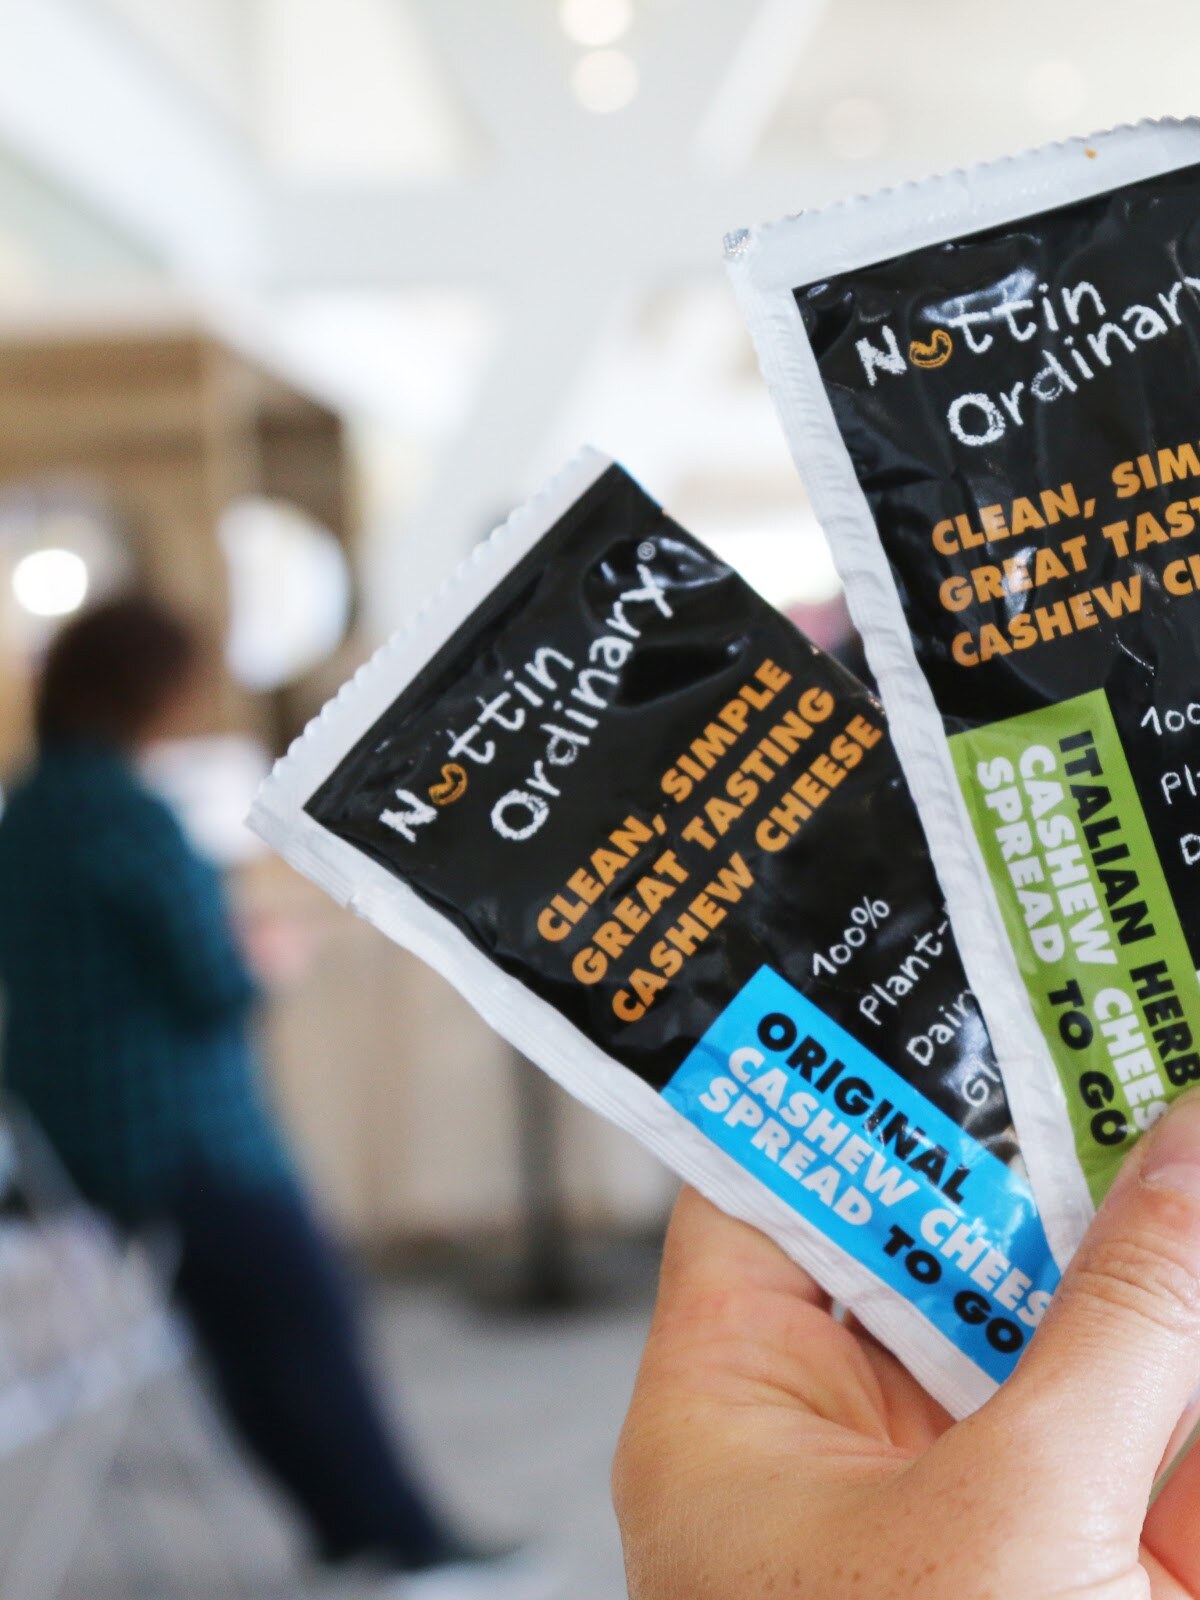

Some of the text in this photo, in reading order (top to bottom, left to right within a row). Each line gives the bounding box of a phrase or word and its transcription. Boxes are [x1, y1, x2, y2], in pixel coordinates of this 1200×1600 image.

[932, 484, 1096, 556] CLEAN,
[939, 537, 1088, 613] GREAT
[951, 577, 1144, 668] CASHEW
[537, 658, 792, 943] CLEAN, SIMPLE
[571, 687, 835, 985] GREAT TASTING
[611, 714, 883, 1023] CASHEW CHEESE
[1057, 730, 1156, 947] ITALIAN
[812, 896, 890, 978] 100%
[859, 903, 949, 1025] Plant-
[906, 989, 973, 1067] Dair
[976, 756, 1128, 1146] SPREAD TO GO
[1019, 744, 1169, 1130] CASHEW CHEES
[698, 1077, 1024, 1354] SPREAD TO GO
[728, 1047, 1054, 1328] CASHEW CHEES
[756, 1012, 976, 1204] ORIGINAL
